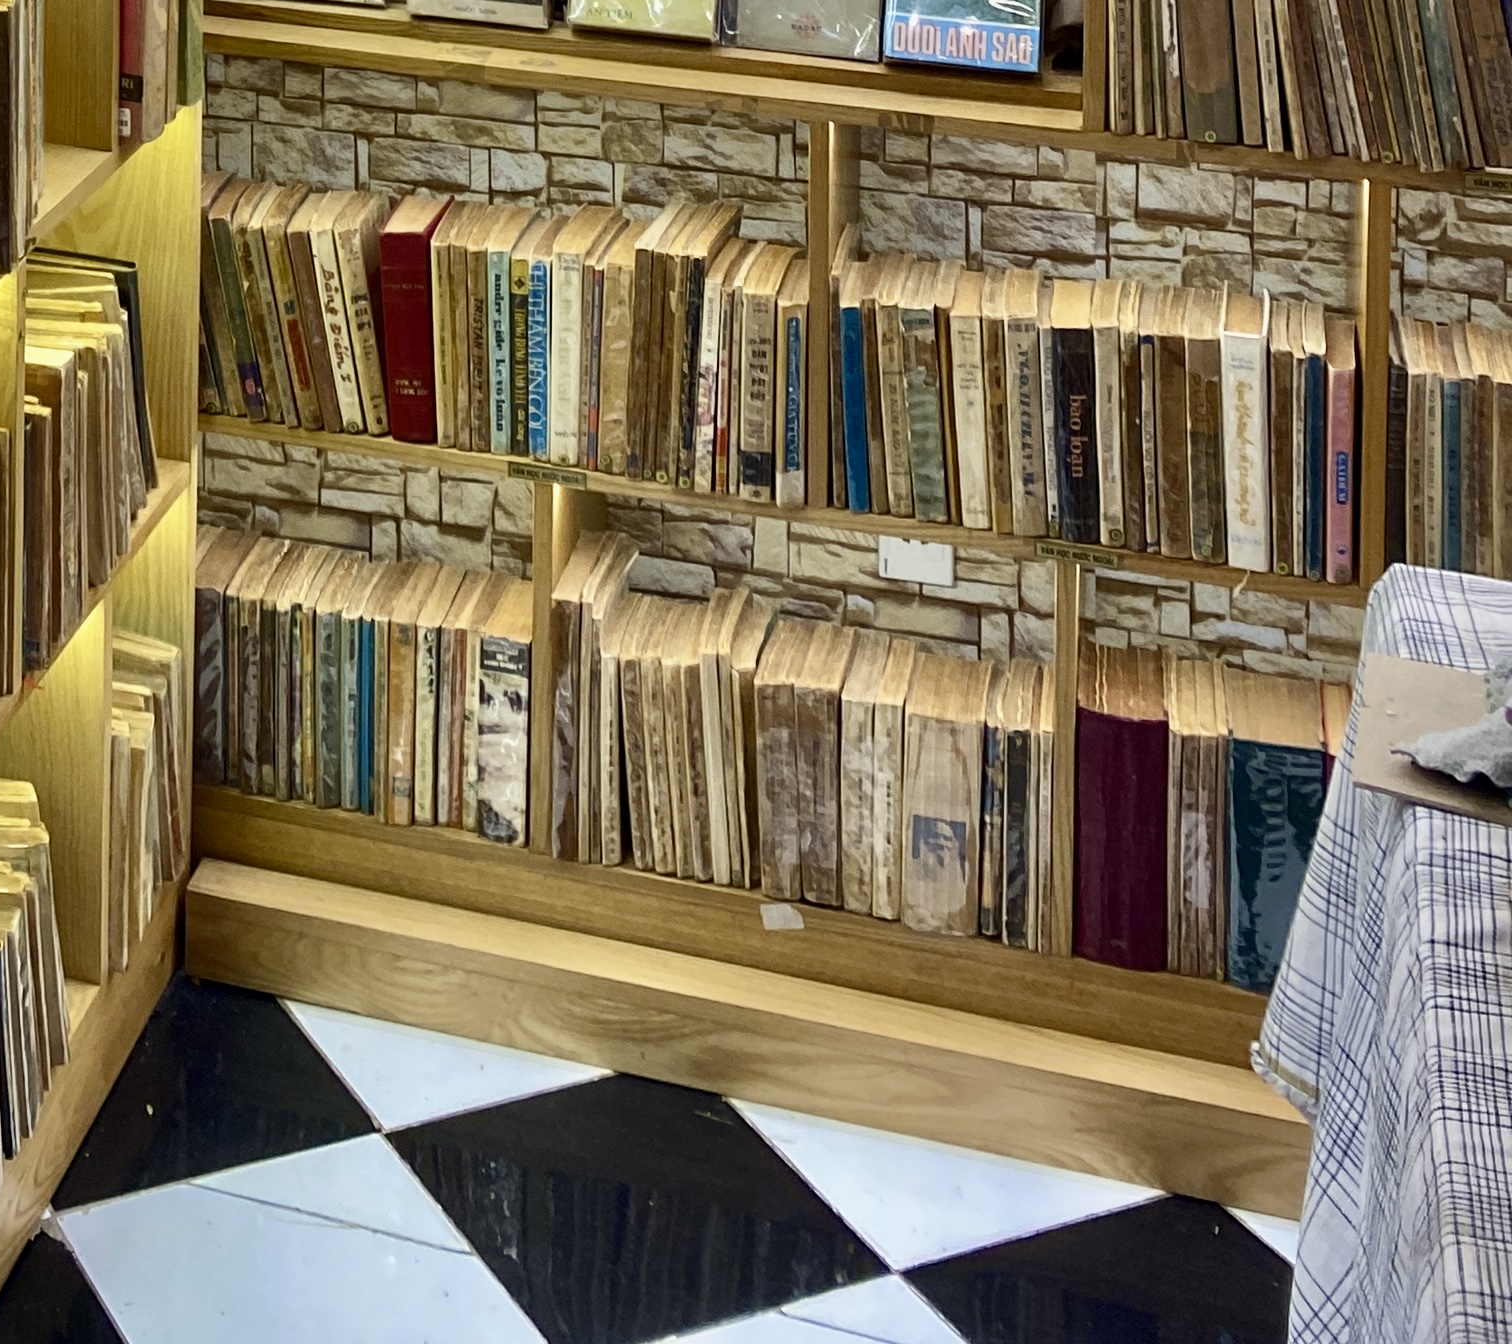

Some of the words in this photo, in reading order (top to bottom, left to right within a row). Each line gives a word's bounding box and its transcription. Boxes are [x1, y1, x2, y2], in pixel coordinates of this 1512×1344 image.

[473, 297, 484, 352] TRISTAN
[526, 467, 541, 480] HỌC
[1040, 545, 1054, 556] VĂN
[1054, 547, 1071, 561] HỌC
